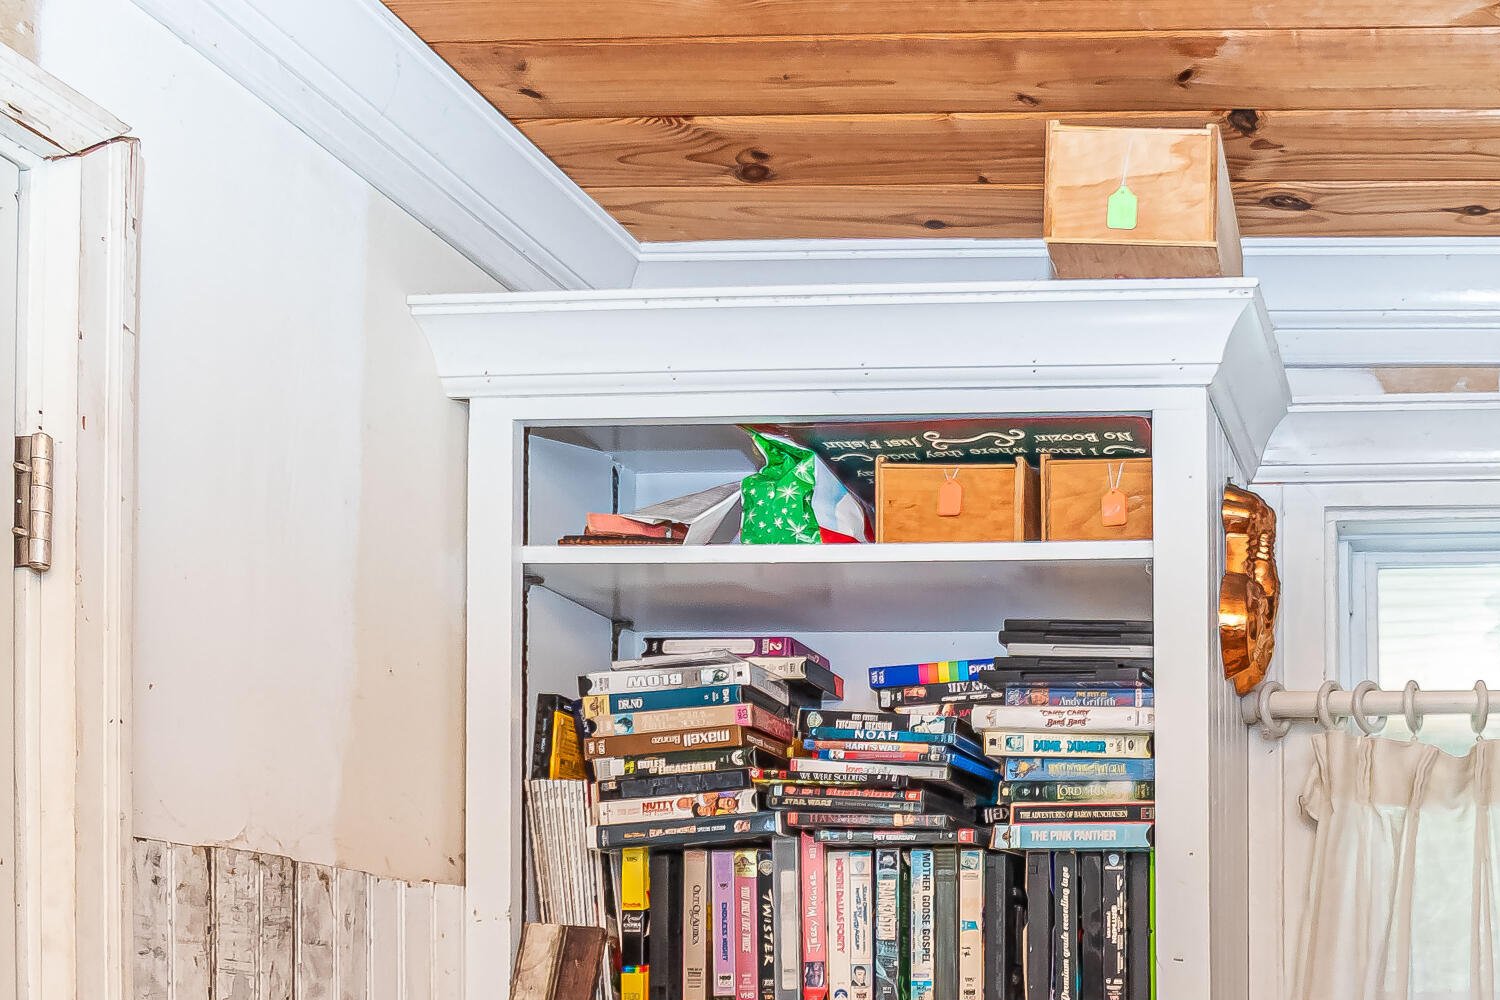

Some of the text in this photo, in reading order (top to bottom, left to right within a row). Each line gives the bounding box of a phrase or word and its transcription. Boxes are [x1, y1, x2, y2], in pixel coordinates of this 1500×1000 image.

[1103, 431, 1133, 443] No
[926, 448, 964, 461] they
[970, 446, 1028, 457] where
[626, 672, 683, 689] BLOW
[1058, 695, 1116, 706] Andy Griffith
[652, 728, 731, 748] maxell Bronze
[854, 729, 899, 741] NOAH
[799, 772, 811, 780] WE
[812, 773, 832, 781] WERE
[642, 800, 674, 811] NUTTY
[782, 798, 833, 807] STAR WARS
[1030, 829, 1117, 842] THE PINK PANTHER
[741, 887, 752, 899] YOU
[741, 900, 752, 916] ONLY
[835, 858, 846, 954] NORTH DALLAS FORTY
[922, 852, 931, 964] MOTHER GOOSE GOSPEL
[721, 902, 729, 936] ENDLESS
[741, 917, 752, 932] LIVE
[761, 889, 775, 967] TWISTER
[806, 920, 822, 953] Jerry
